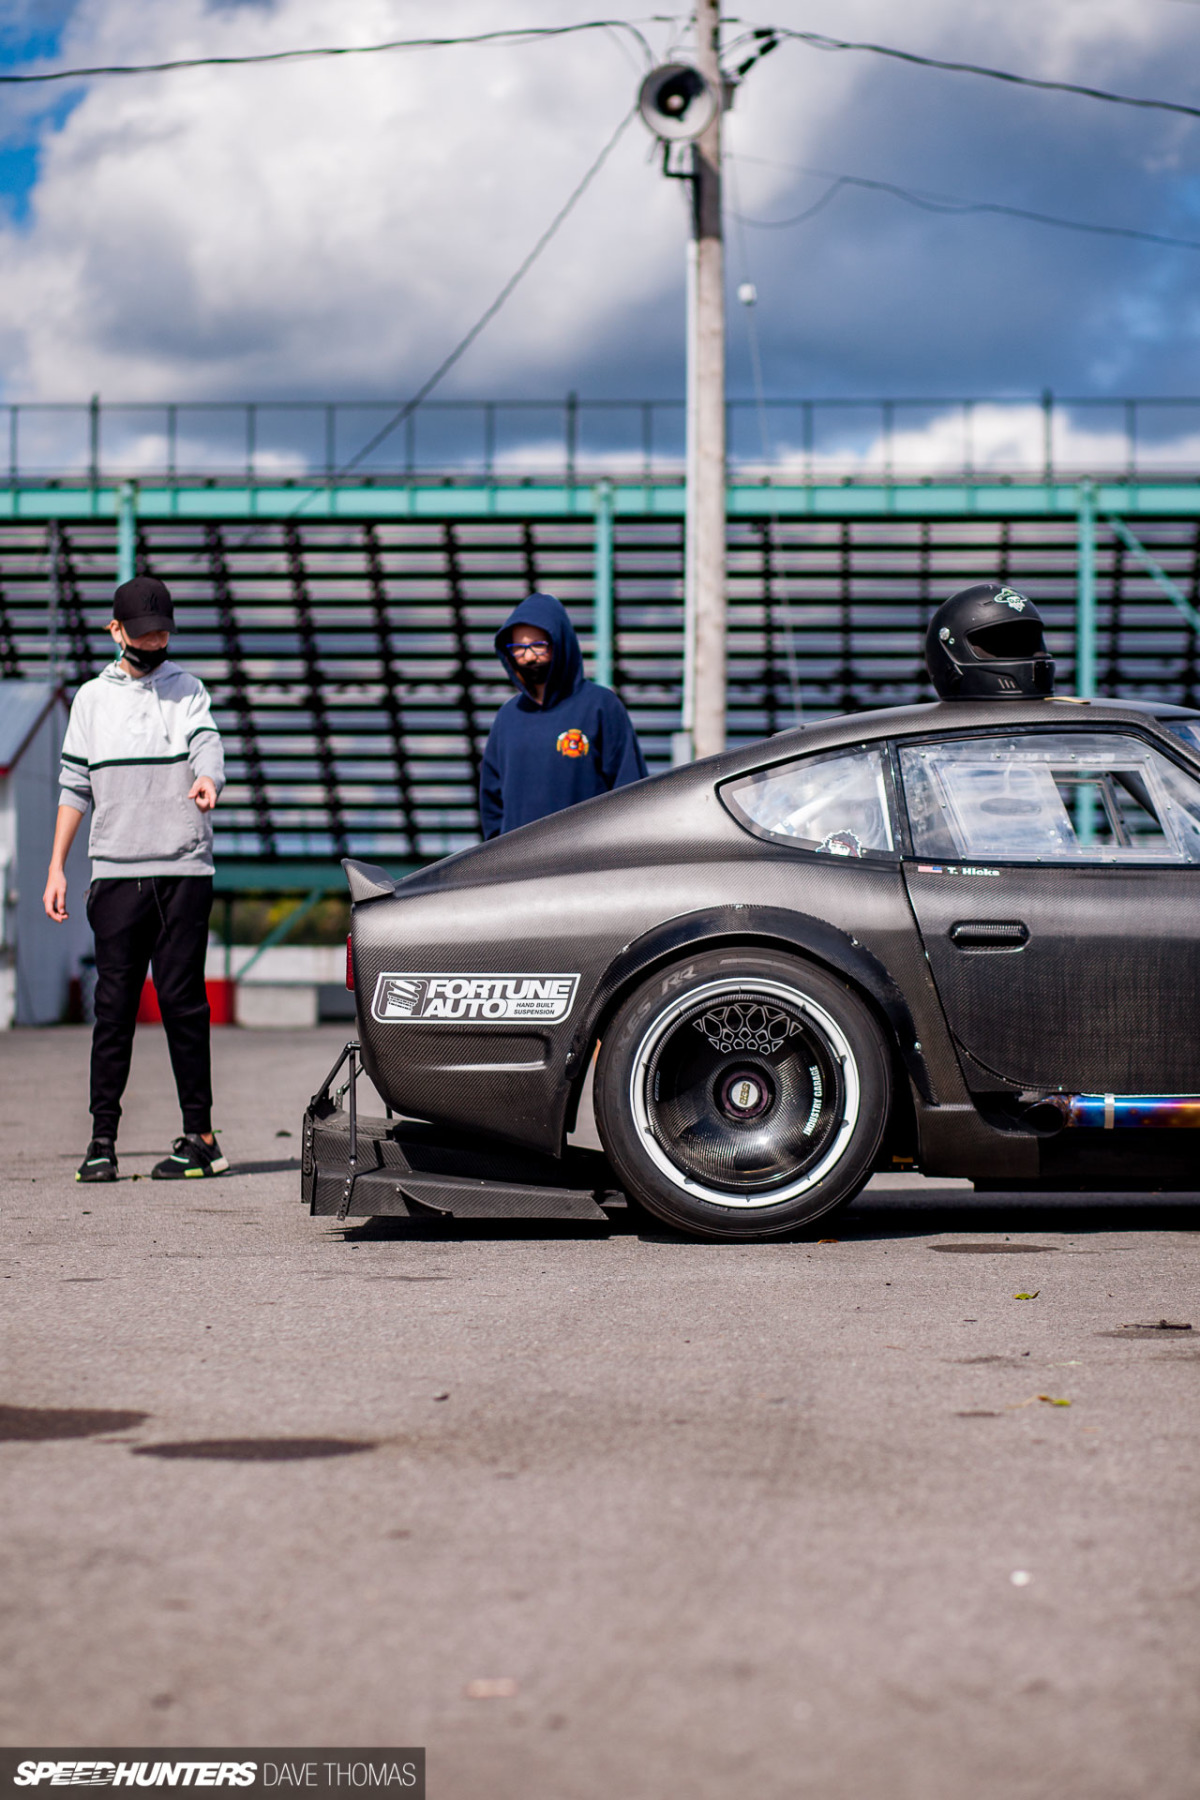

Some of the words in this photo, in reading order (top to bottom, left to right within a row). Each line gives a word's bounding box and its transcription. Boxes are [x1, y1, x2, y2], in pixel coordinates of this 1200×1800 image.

[427, 979, 573, 999] FORTUNE
[422, 998, 508, 1018] AUTO
[809, 1065, 823, 1097] GARAGE
[802, 1098, 822, 1136] INDUSTRY
